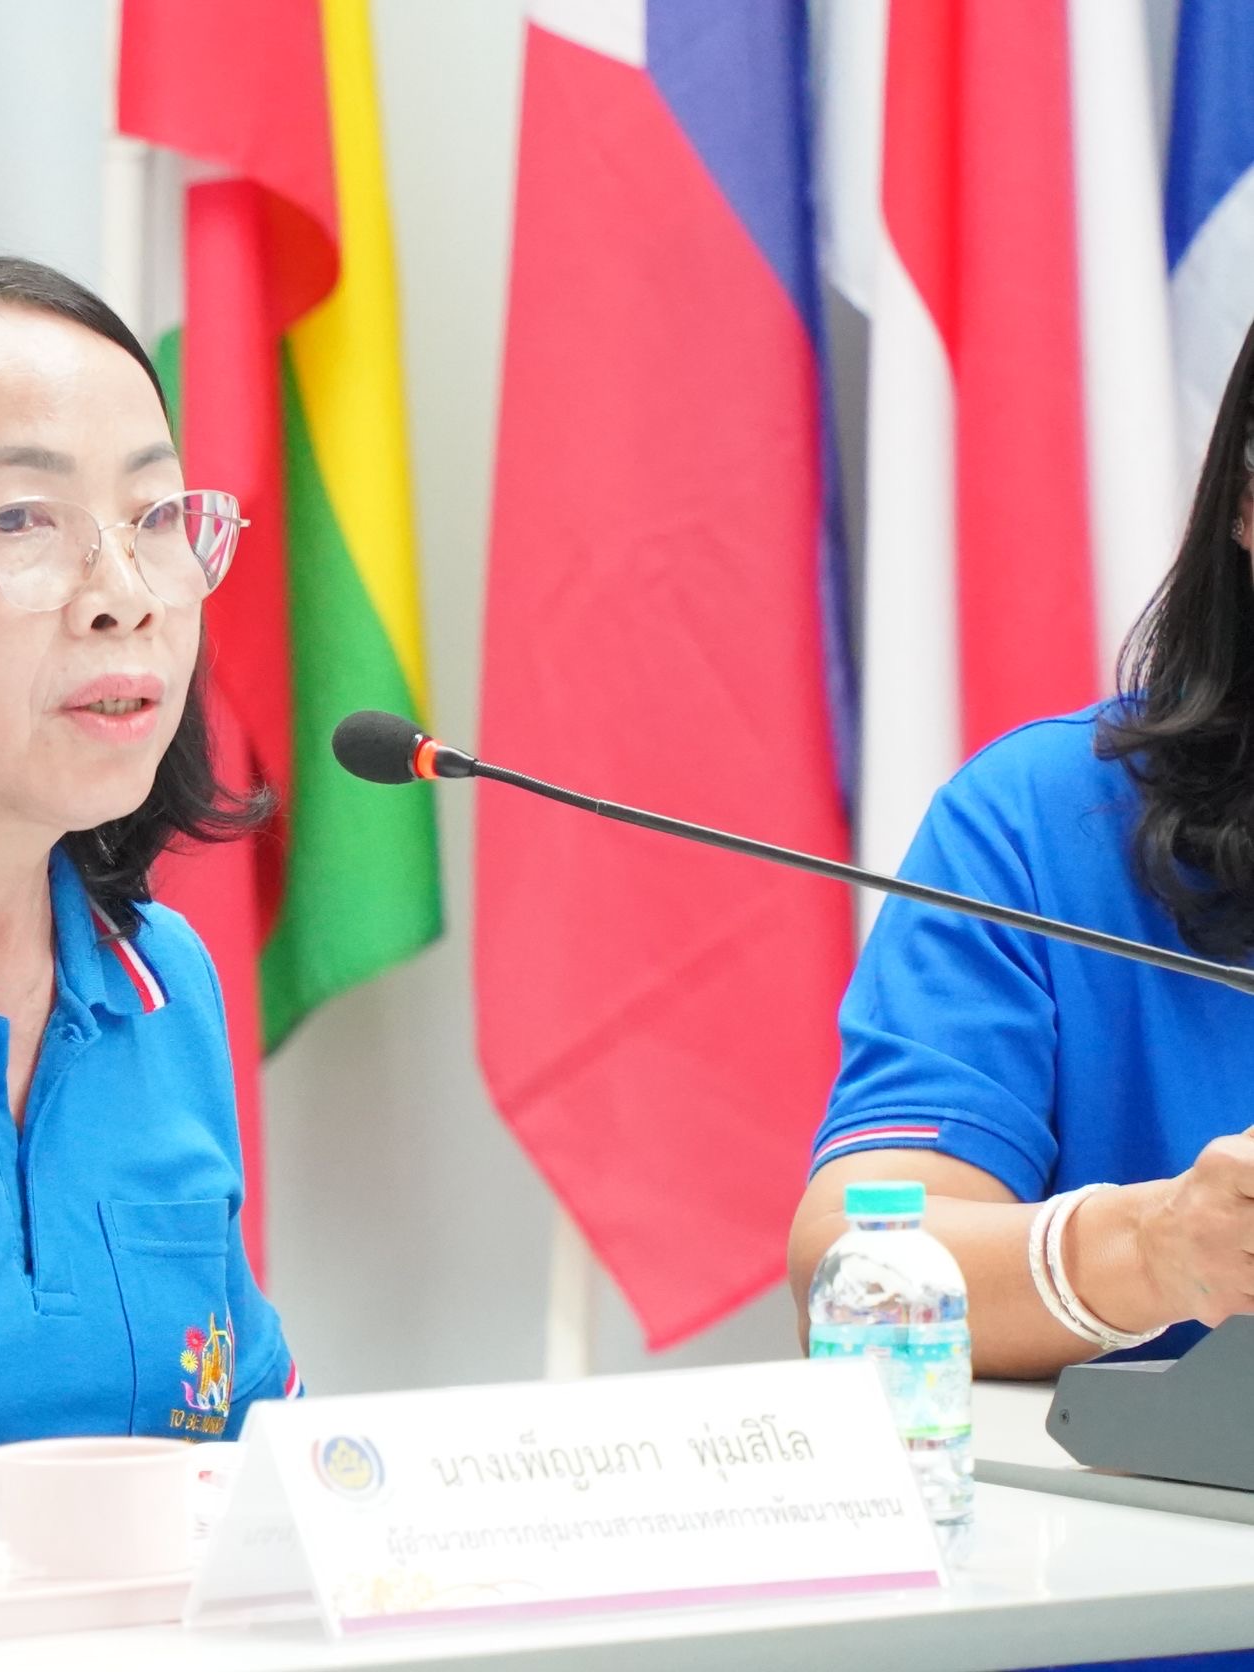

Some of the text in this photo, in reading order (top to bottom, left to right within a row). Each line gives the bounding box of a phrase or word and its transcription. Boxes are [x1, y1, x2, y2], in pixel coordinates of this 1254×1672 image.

[170, 1408, 185, 1428] TO
[186, 1413, 202, 1431] BE
[431, 1414, 815, 1492] นางเพ็ญนภา พุ่มสิโล
